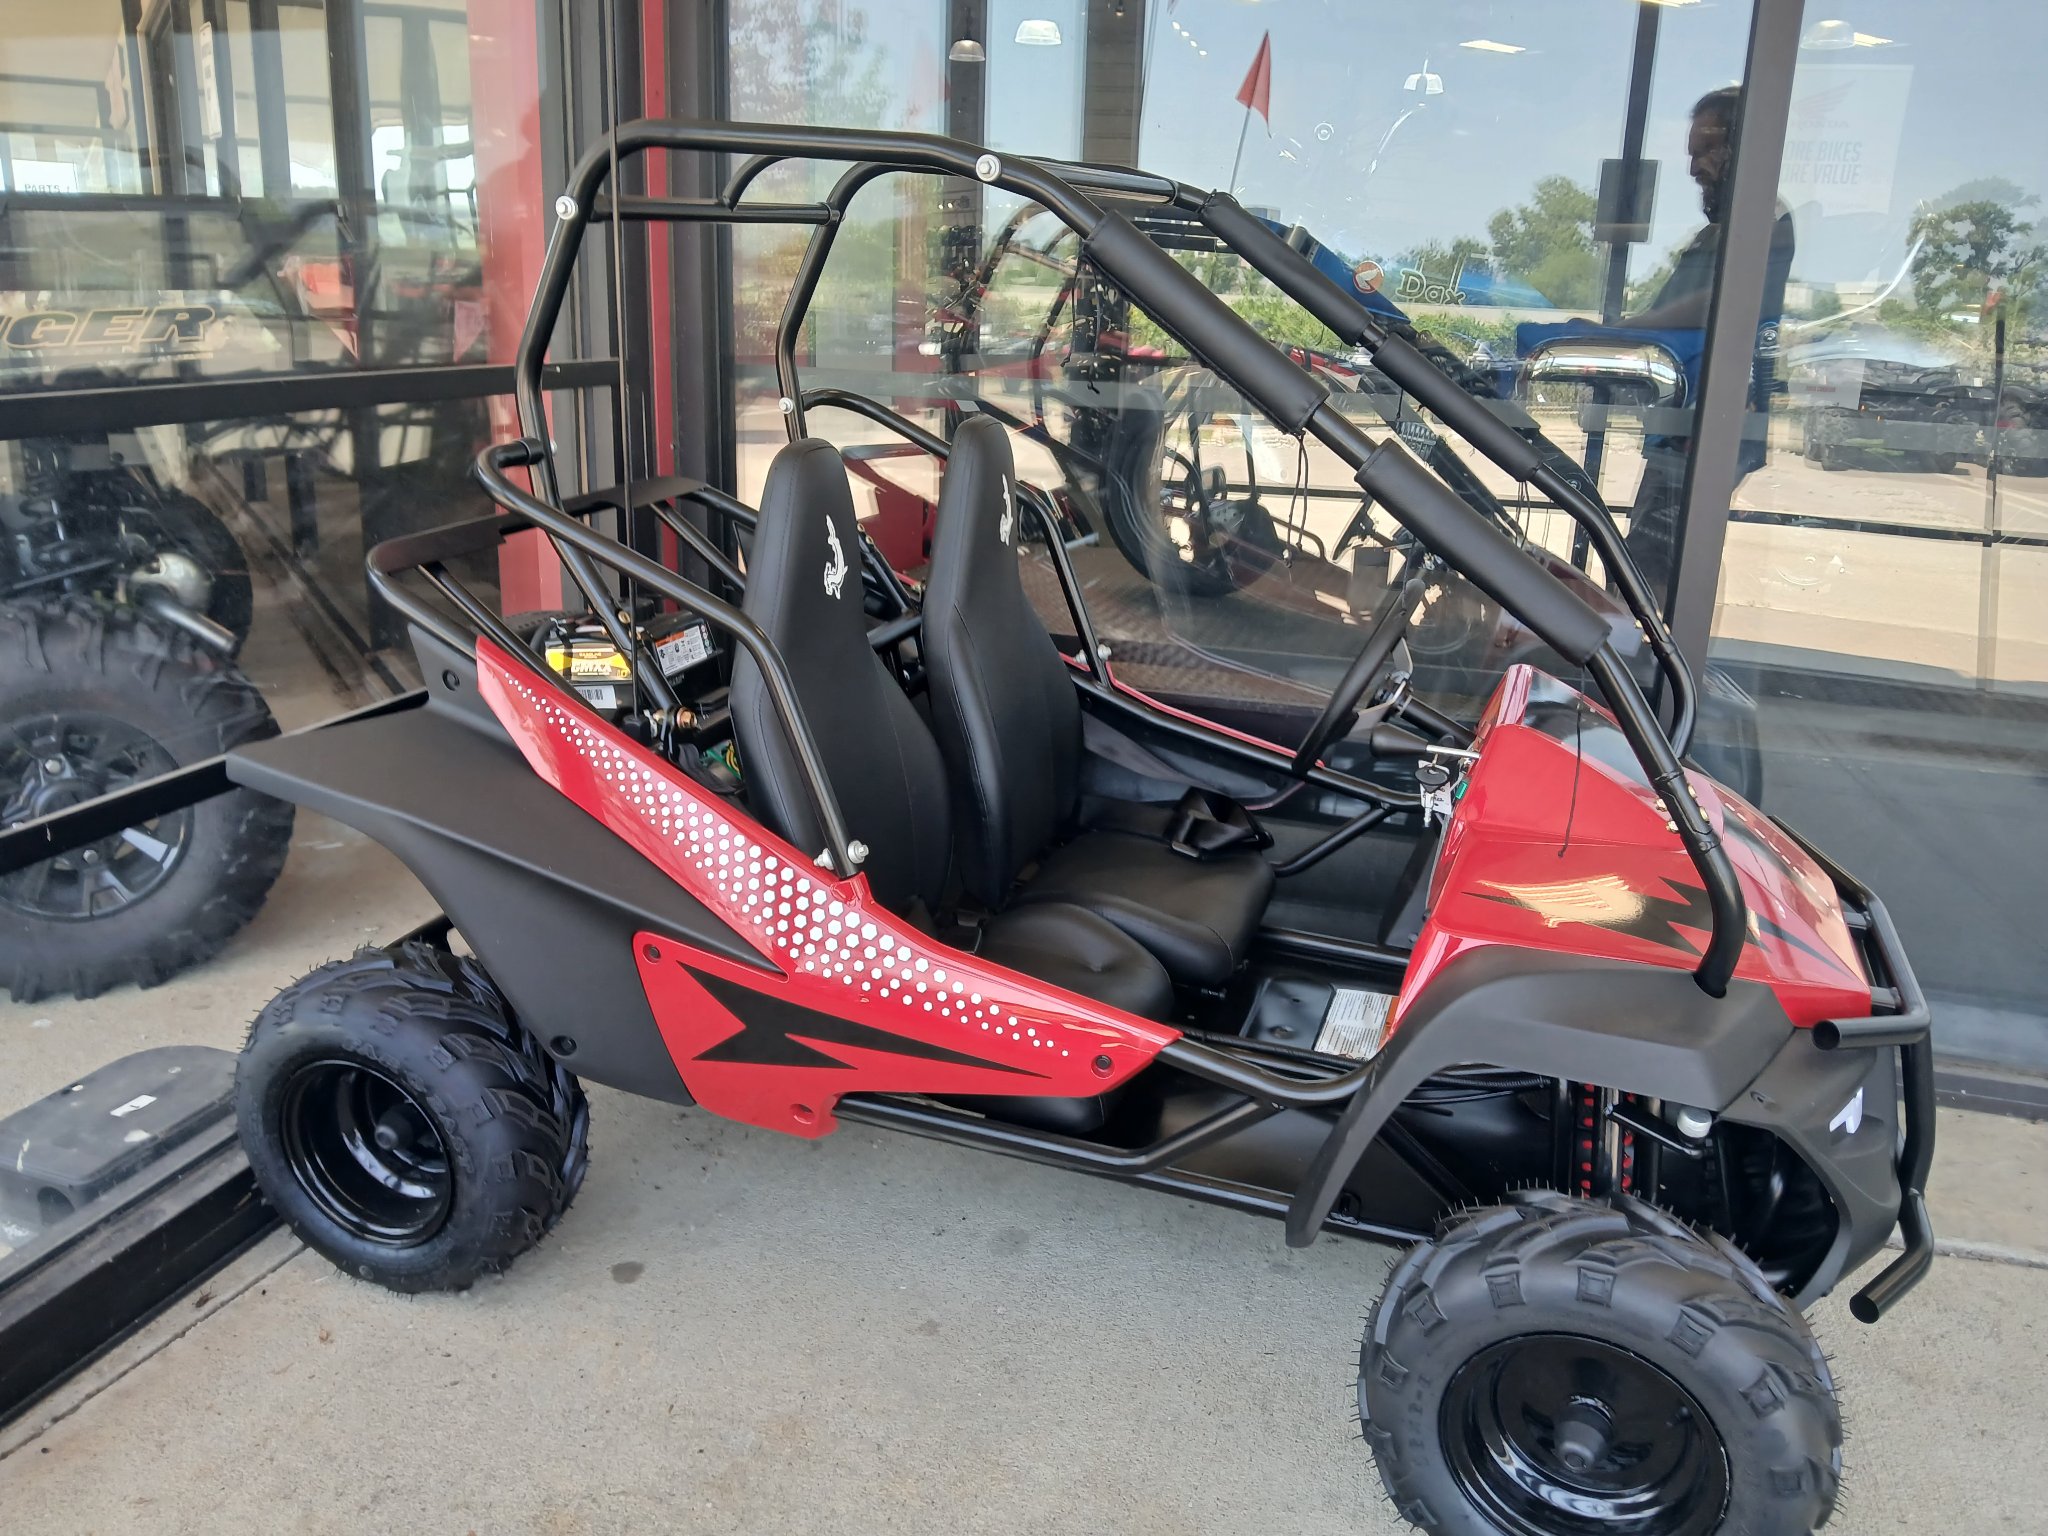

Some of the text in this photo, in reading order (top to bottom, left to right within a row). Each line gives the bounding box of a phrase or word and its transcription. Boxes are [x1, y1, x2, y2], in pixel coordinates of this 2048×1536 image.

[1817, 141, 1862, 162] BIKES
[1813, 163, 1861, 184] VALUE
[1395, 267, 1466, 305] Dax
[0, 304, 216, 349] GER
